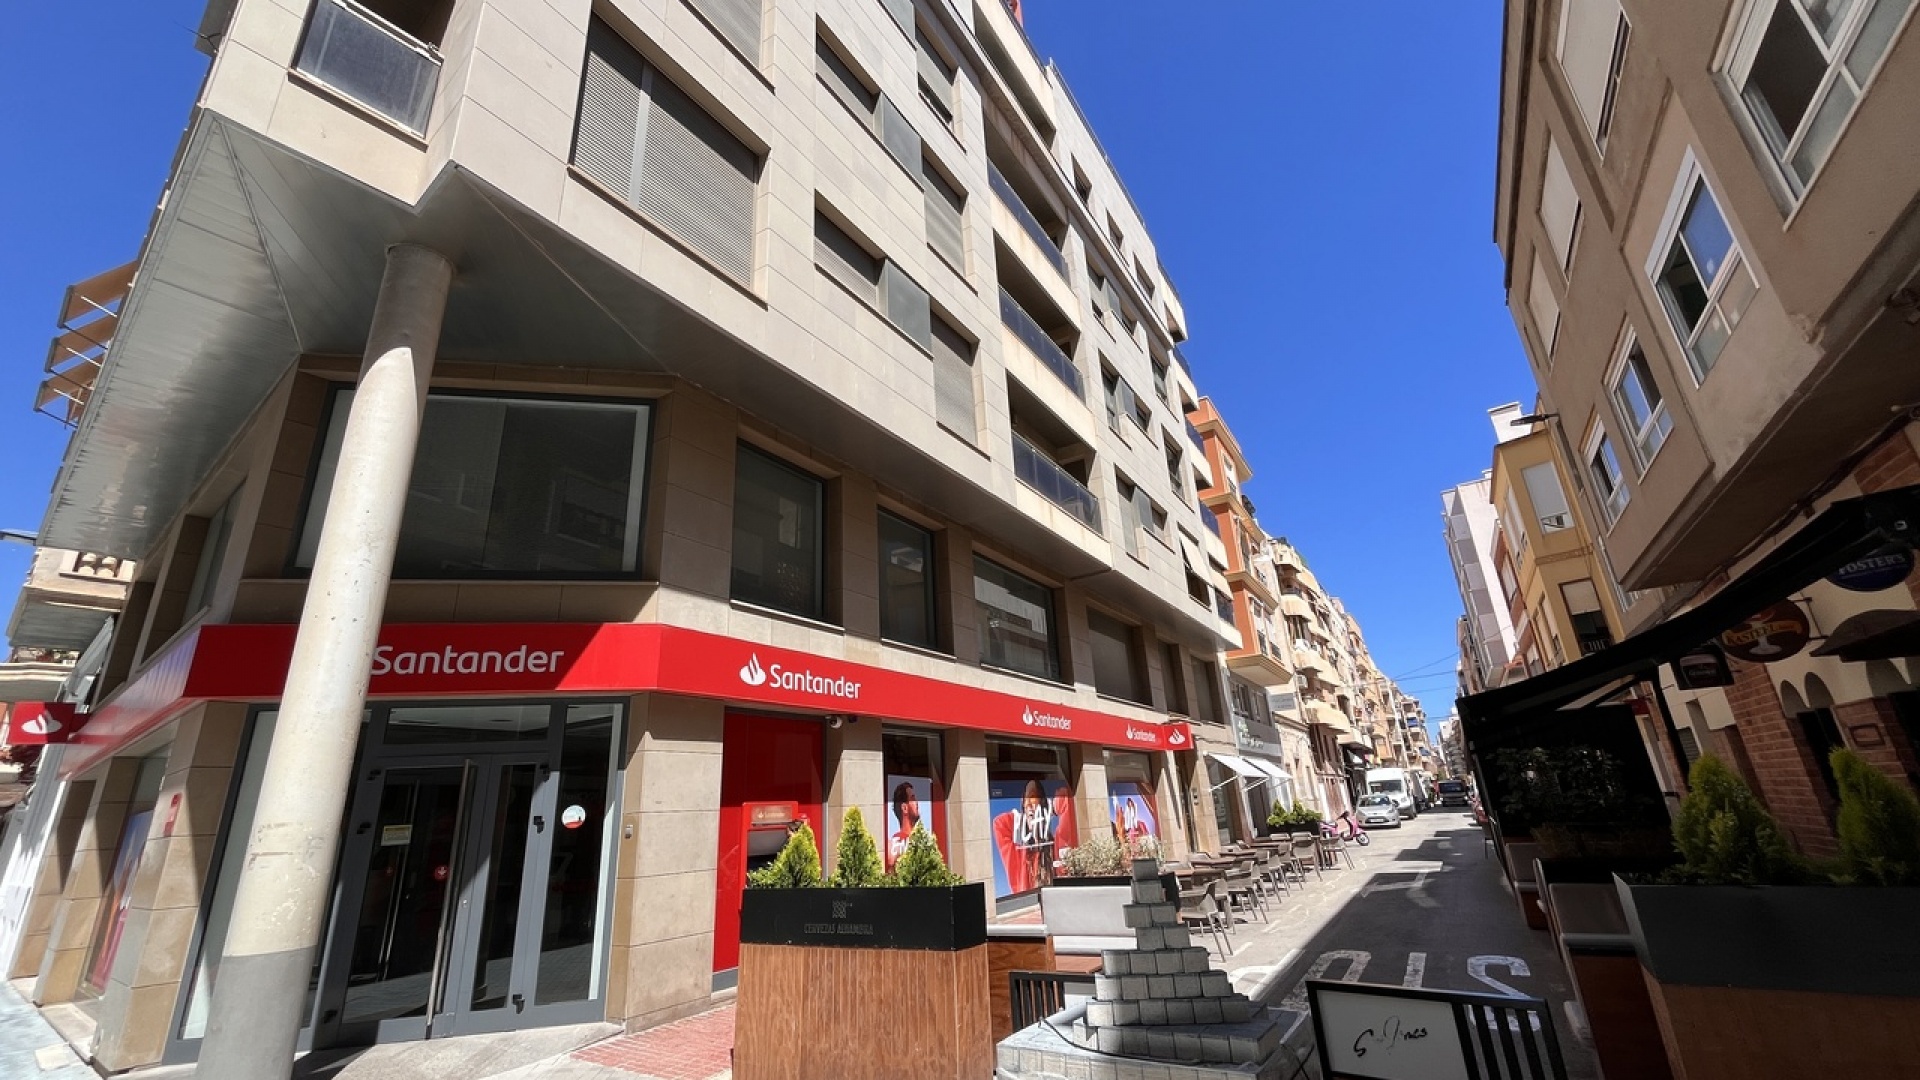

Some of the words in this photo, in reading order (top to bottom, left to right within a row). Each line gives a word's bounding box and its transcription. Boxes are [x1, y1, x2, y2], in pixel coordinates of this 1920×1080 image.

[371, 644, 565, 676] Santander
[769, 664, 861, 699] Santander
[1033, 709, 1072, 730] Santander
[1012, 797, 1054, 843] PLAY
